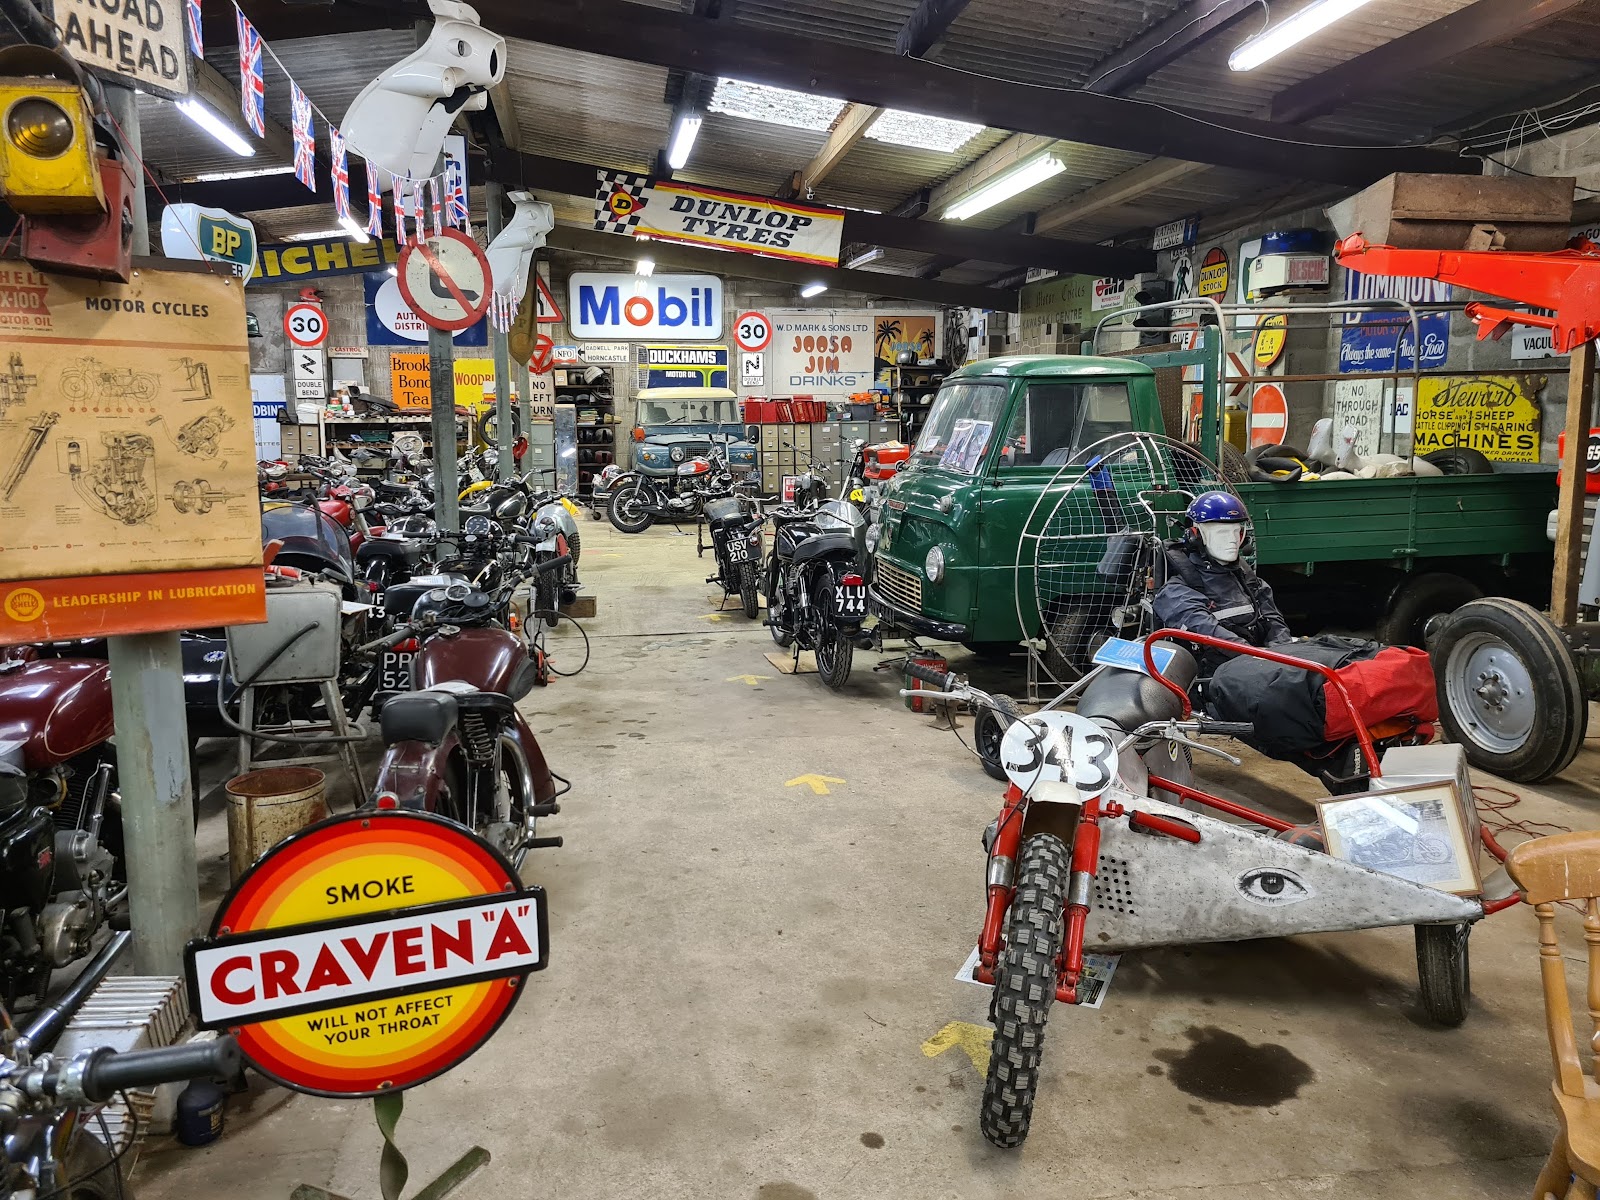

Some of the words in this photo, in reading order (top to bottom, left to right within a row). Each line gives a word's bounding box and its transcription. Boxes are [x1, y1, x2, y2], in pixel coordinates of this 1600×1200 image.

[77, 0, 164, 32] OAD
[63, 12, 179, 80] AHEAD
[669, 194, 814, 232] DUNLOP
[682, 216, 795, 248] TYRES
[1154, 220, 1185, 238] KATHRYN
[211, 225, 242, 257] BP
[1155, 234, 1180, 249] AVENUE
[251, 238, 400, 278] ICHEL
[0, 271, 49, 286] HELL
[1200, 266, 1227, 282] DUNLOP
[1202, 281, 1223, 292] STOCK
[85, 297, 145, 314] MOTOR
[152, 301, 209, 318] CYCLES
[579, 285, 713, 327] Mobil
[0, 315, 30, 325] OTOR
[34, 316, 53, 327] OIL
[1055, 307, 1083, 323] CENTRE
[292, 317, 321, 333] 30
[394, 322, 429, 331] DISTRI
[739, 323, 766, 340] 30
[827, 324, 851, 332] SONS
[852, 324, 868, 332] LTD
[792, 335, 852, 354] JOOSA
[1171, 332, 1189, 344] GIVE
[1340, 342, 1365, 365] Always
[1364, 343, 1375, 360] the
[1419, 333, 1445, 361] Good
[392, 358, 430, 371] Brook
[649, 350, 717, 364] DUCKHAMS
[804, 355, 840, 374] JIM
[665, 370, 686, 378] MOTOR
[687, 370, 697, 378] OIL
[790, 375, 856, 386] DRINKS
[532, 381, 546, 390] NO
[1351, 385, 1364, 396] NO
[403, 391, 429, 405] Tea
[530, 393, 552, 402] EFT
[530, 405, 553, 415] URN
[1336, 399, 1378, 412] THROUGH
[1344, 415, 1368, 426] ROAD
[1415, 410, 1453, 420] HORSE
[1475, 411, 1515, 420] SHEEP
[1437, 421, 1466, 431] CLIPPING
[1414, 432, 1534, 449] MACHINES
[727, 539, 748, 554] USV
[729, 549, 749, 563] 210
[53, 591, 142, 609] LEADERSHIP
[147, 588, 163, 600] IN
[168, 584, 256, 600] LUBRICATION
[835, 585, 866, 600] XLU
[835, 598, 866, 613] 744
[1005, 717, 1114, 792] 343
[325, 875, 415, 905] SMOKE
[210, 918, 475, 1006] CRAVEN
[306, 1012, 349, 1033] WILL
[354, 1006, 388, 1023] NOT
[394, 994, 454, 1017] AFFECT
[323, 1026, 371, 1046] YOUR
[379, 1013, 441, 1036] THROAT
